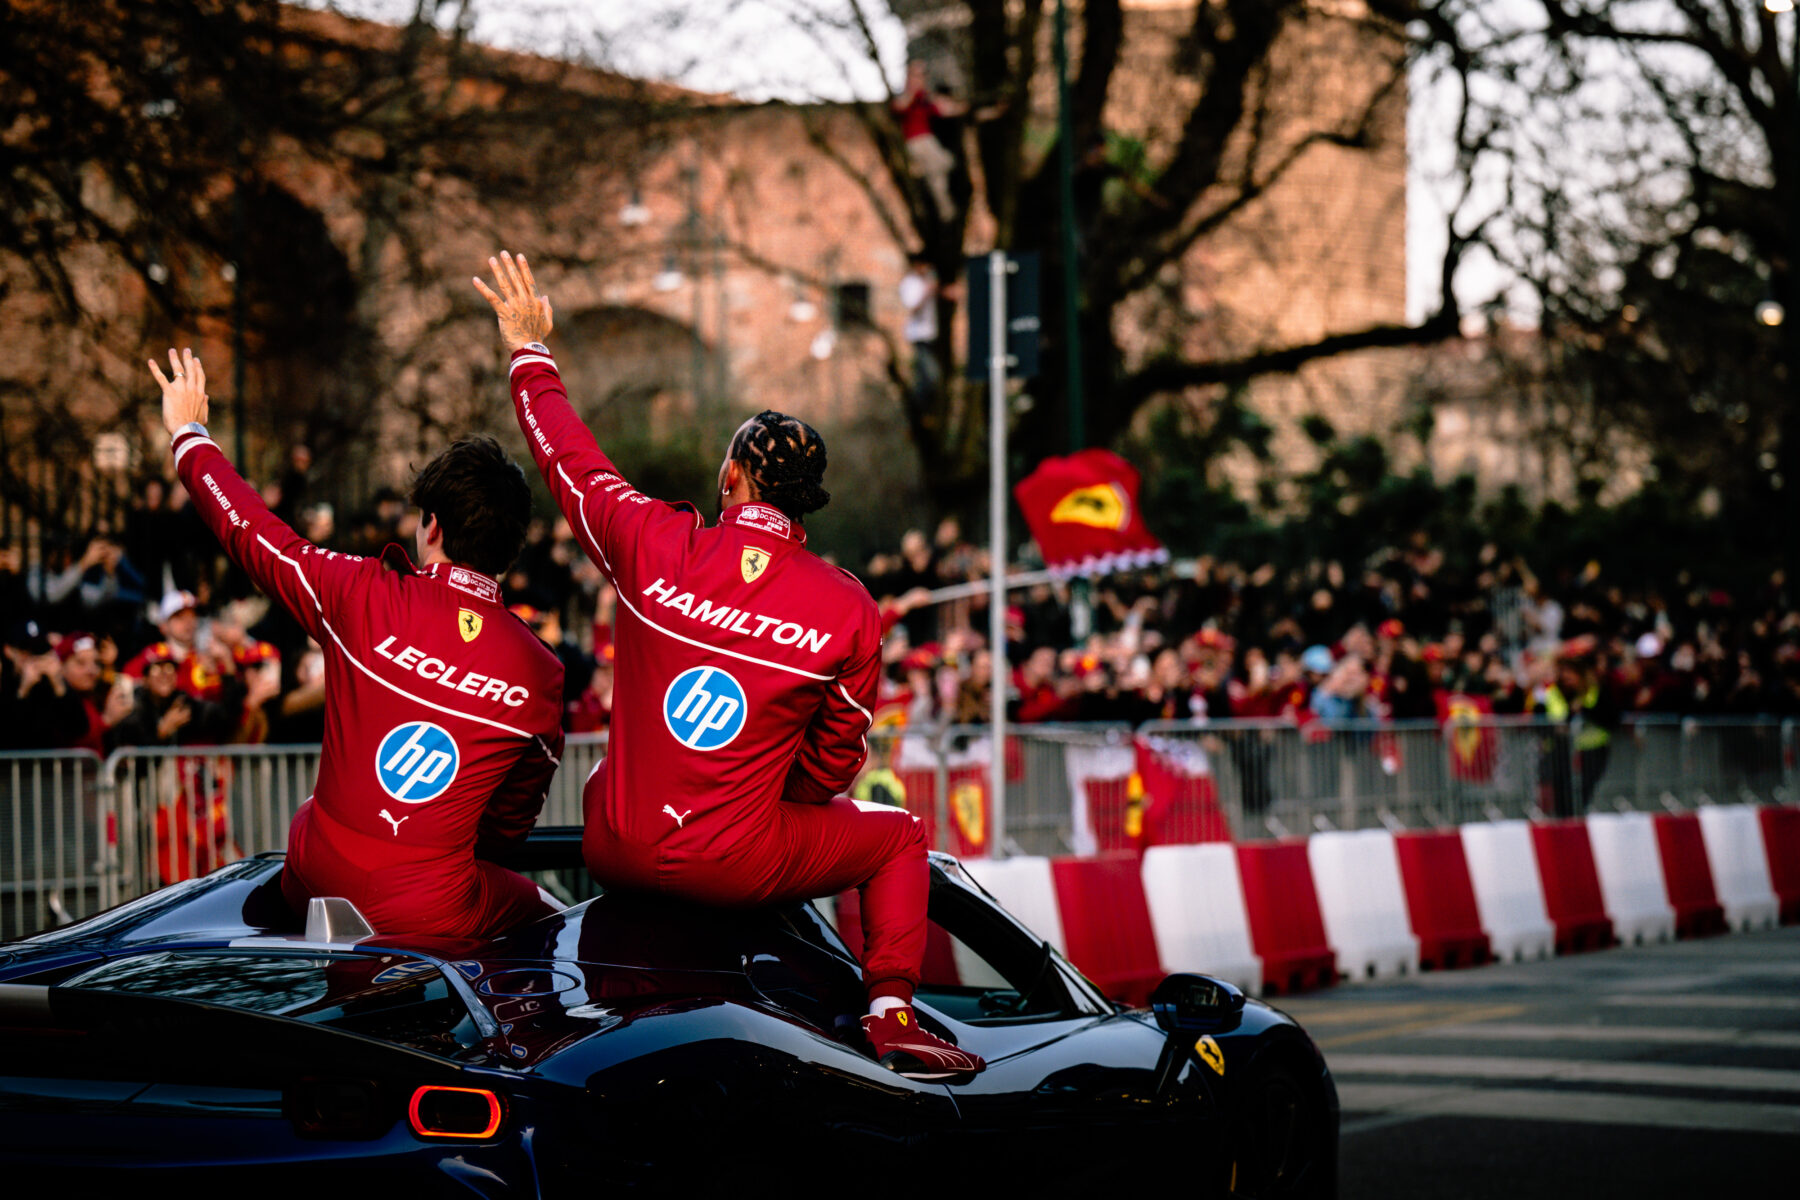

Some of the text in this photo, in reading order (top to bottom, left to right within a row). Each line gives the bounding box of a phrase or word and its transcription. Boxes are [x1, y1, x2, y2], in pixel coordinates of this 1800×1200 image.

[532, 427, 555, 457] MILLE
[202, 473, 232, 511] RICHARD
[642, 577, 833, 654] HAMILTON
[373, 635, 530, 707] LECLERC
[672, 667, 740, 747] hp
[383, 723, 453, 800] hp
